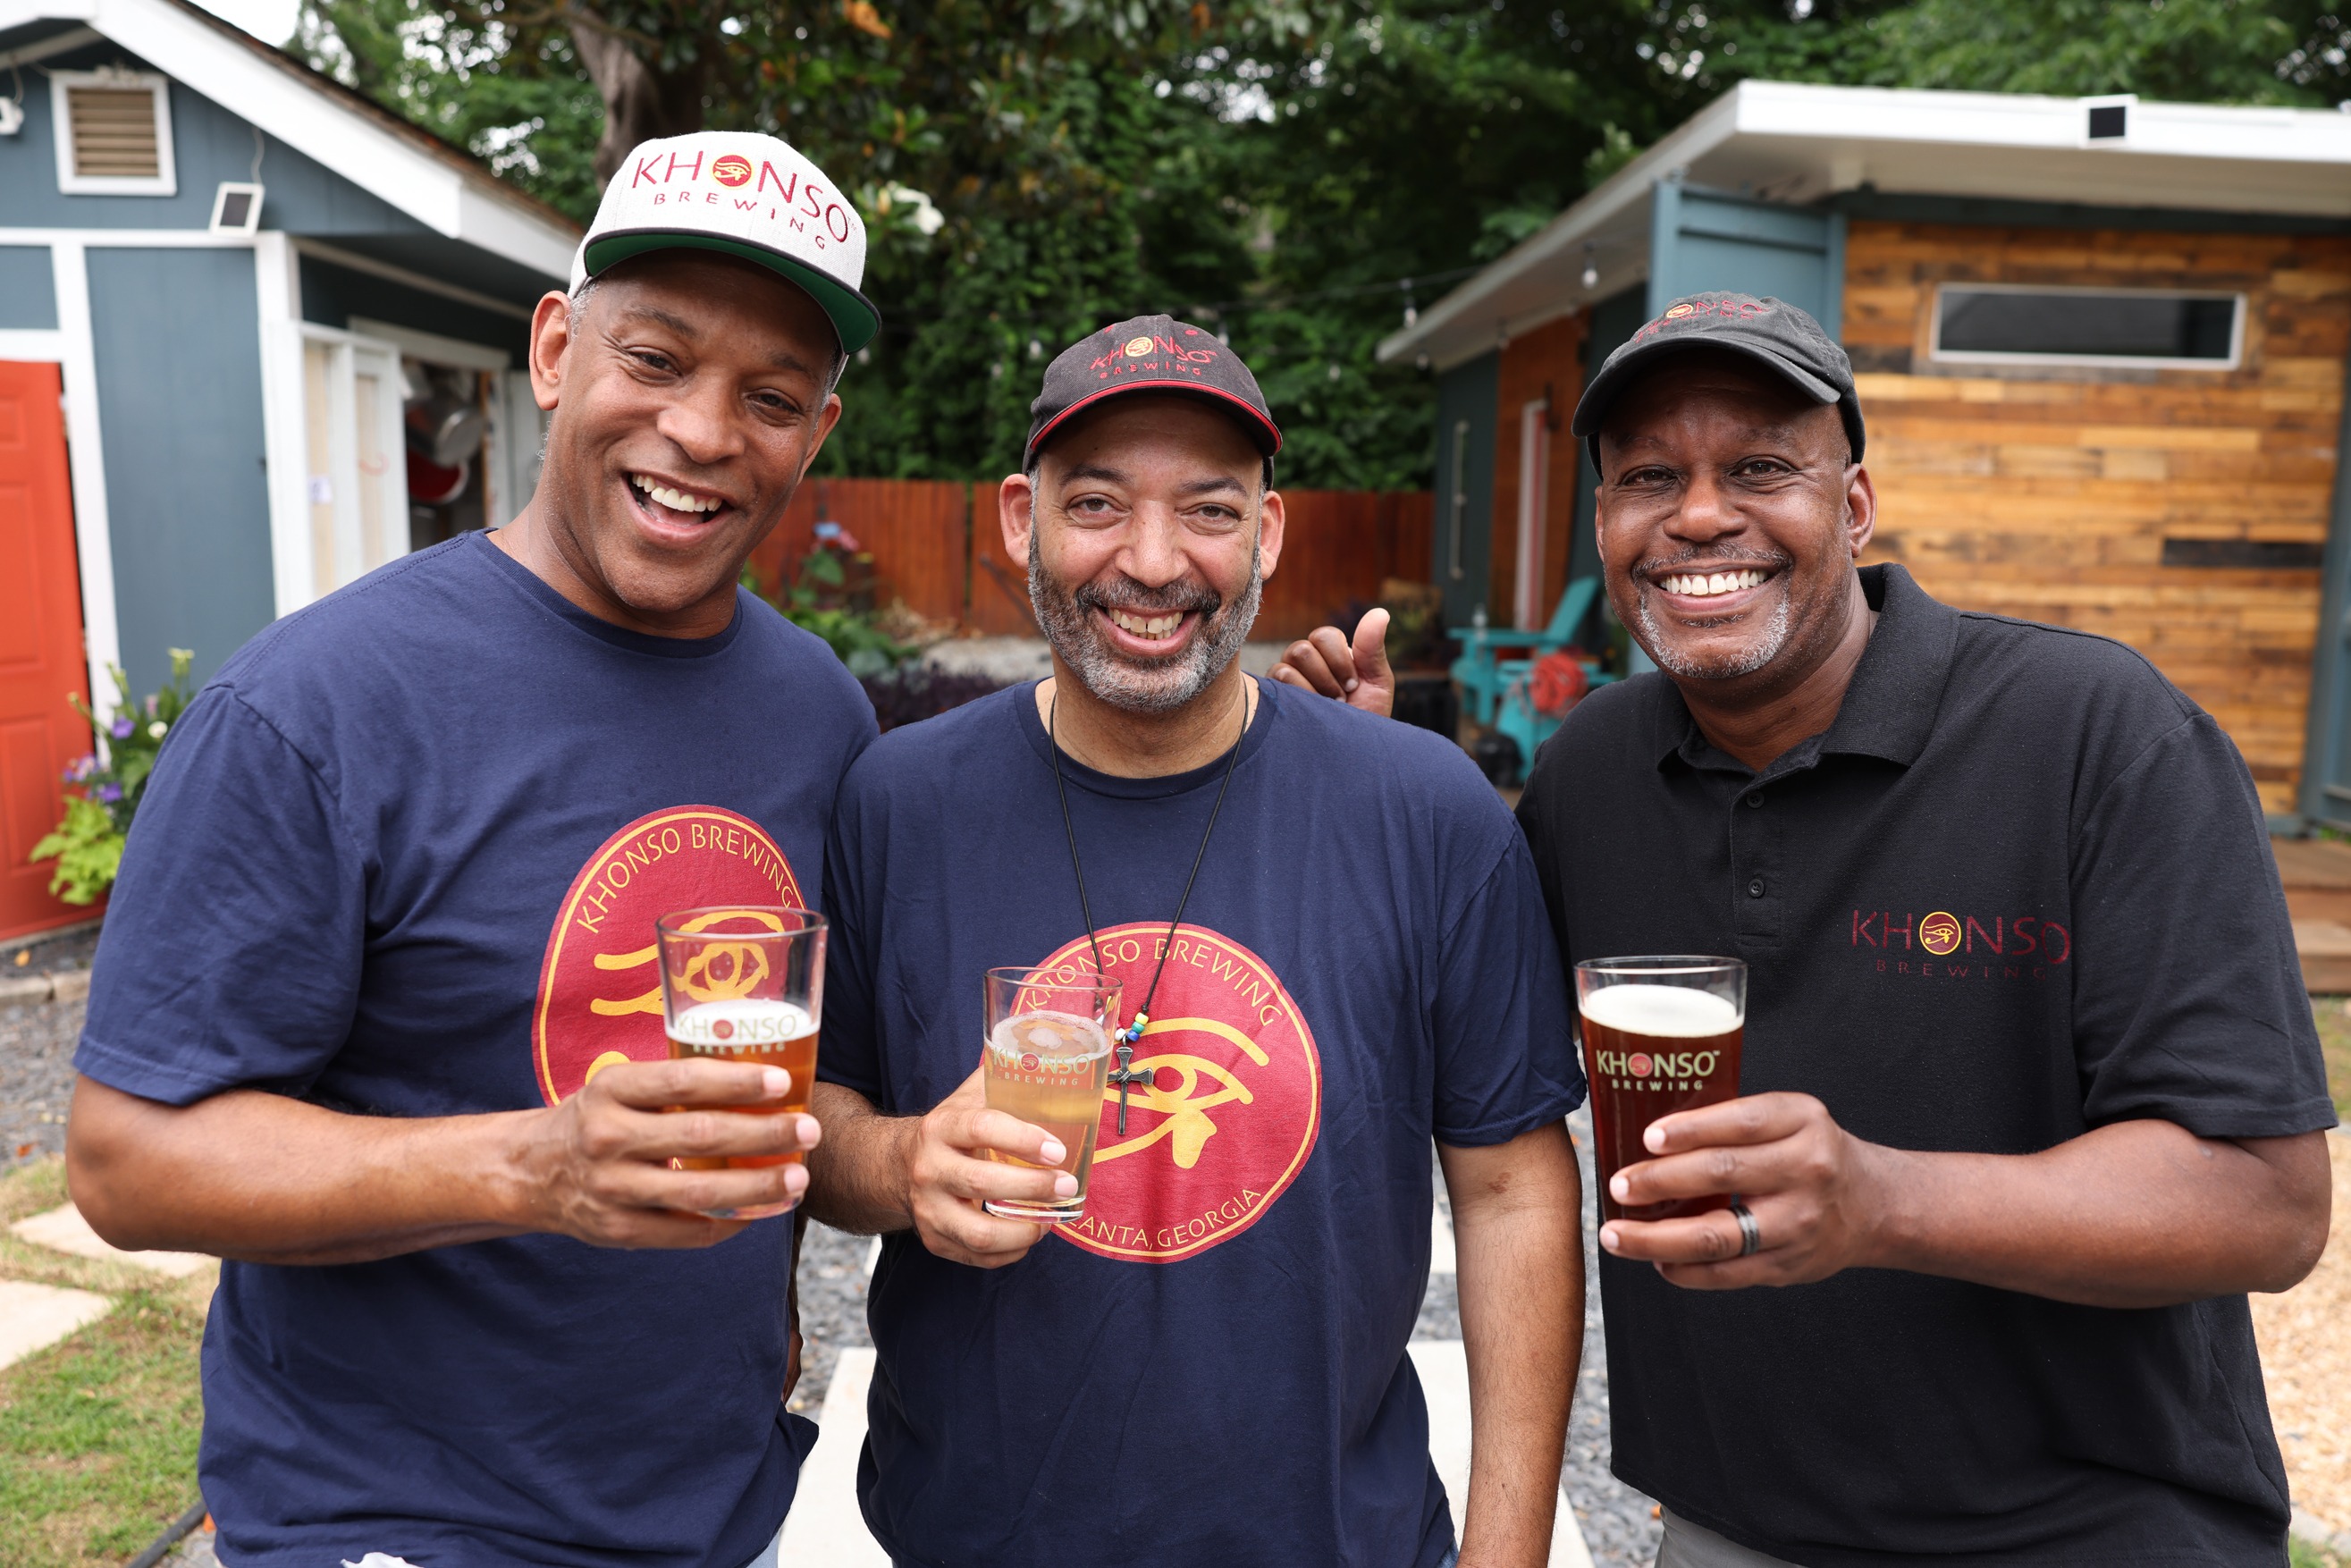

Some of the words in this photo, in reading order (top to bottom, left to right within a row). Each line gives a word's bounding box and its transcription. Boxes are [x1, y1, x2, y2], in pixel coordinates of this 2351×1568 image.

[653, 191, 826, 249] BREWING
[1099, 361, 1202, 380] BREWING
[577, 827, 681, 934] KHONSO
[691, 823, 794, 909] BREWING
[1851, 909, 2070, 965] KHONSO
[1153, 938, 1284, 1027] BREWING
[1876, 959, 2047, 980] BREWING
[692, 1041, 787, 1056] BREWING
[1004, 1073, 1079, 1086] BREWING
[1611, 1078, 1704, 1092] BREWING
[1067, 1215, 1153, 1251] ANTA,
[1157, 1187, 1262, 1248] GEORGIA
